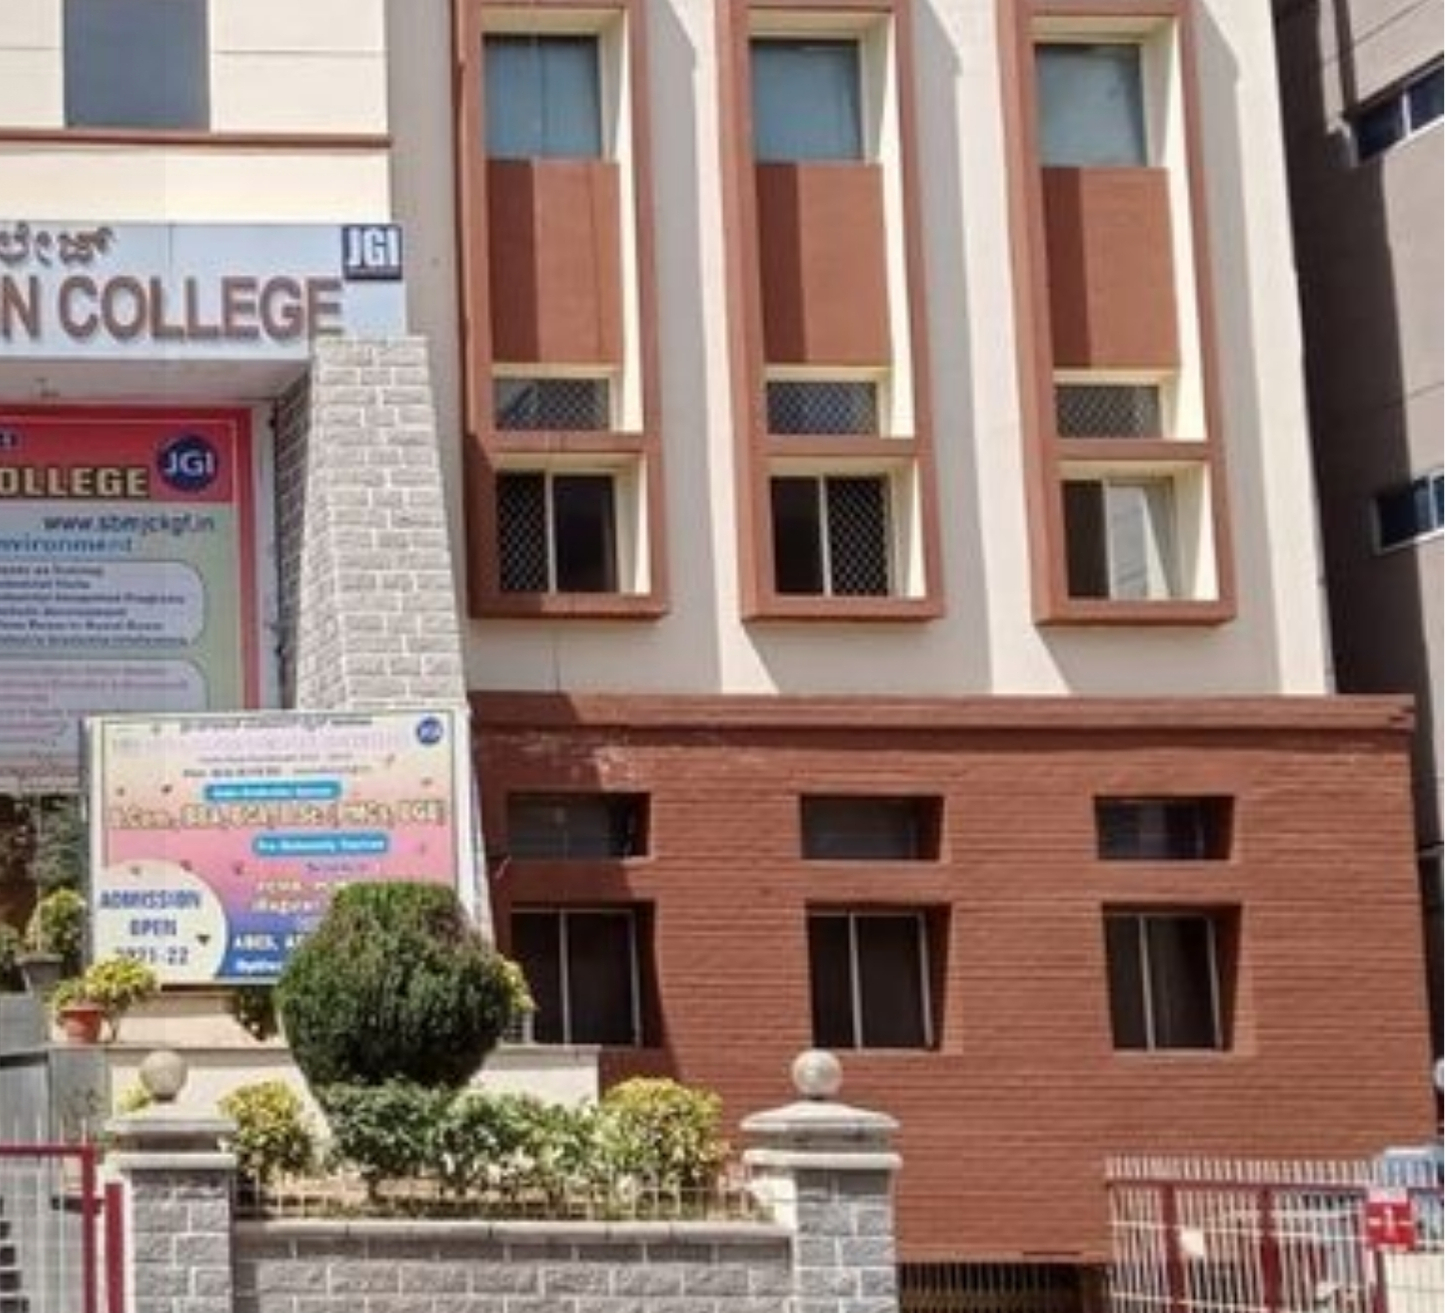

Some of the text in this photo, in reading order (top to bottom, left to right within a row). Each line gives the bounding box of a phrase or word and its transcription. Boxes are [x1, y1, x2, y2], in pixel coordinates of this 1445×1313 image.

[344, 228, 401, 269] JGI
[62, 274, 343, 342] COLLEGE
[163, 451, 214, 477] JGI
[99, 889, 202, 909] ADMISSION
[129, 918, 178, 937] OPEN
